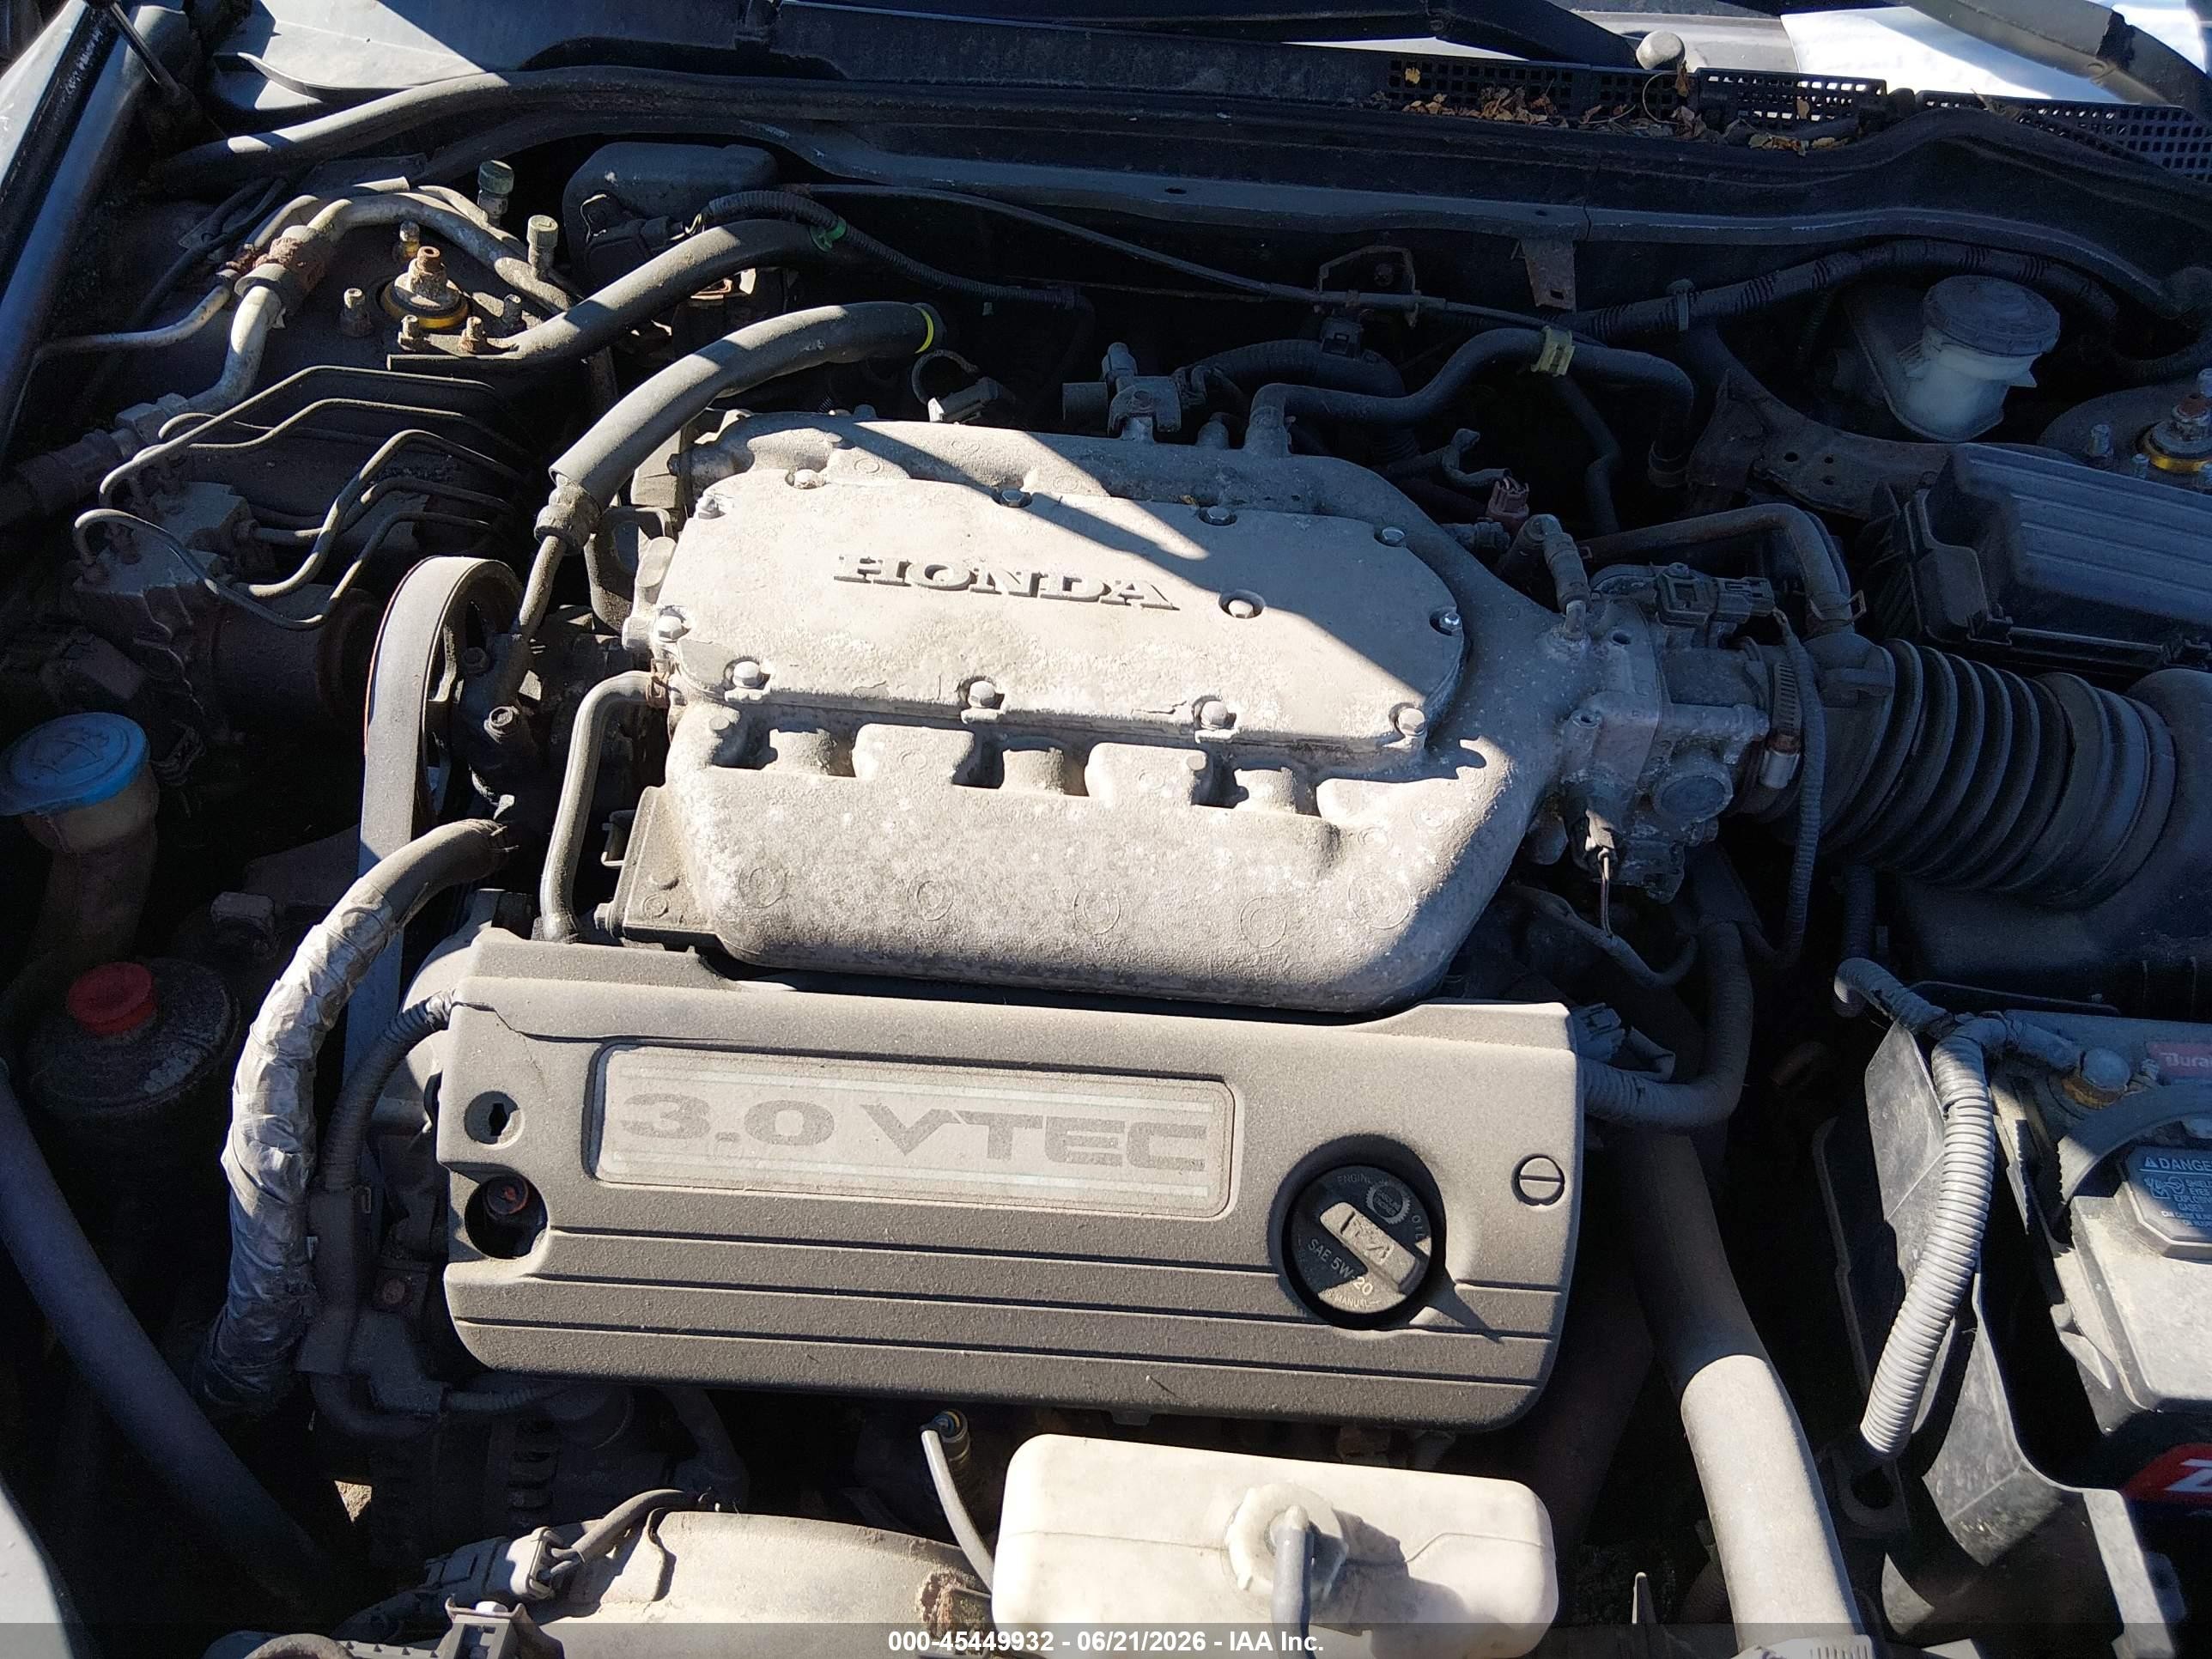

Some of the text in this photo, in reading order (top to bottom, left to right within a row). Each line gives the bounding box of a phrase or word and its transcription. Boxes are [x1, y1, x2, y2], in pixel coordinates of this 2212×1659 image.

[833, 556, 1181, 611] HONDA
[620, 1092, 1207, 1171] 3.0 VTEC
[2158, 1157, 2212, 1172] DANGE
[1307, 1237, 1333, 1263] SAE
[1330, 1256, 1374, 1297] 5W-20
